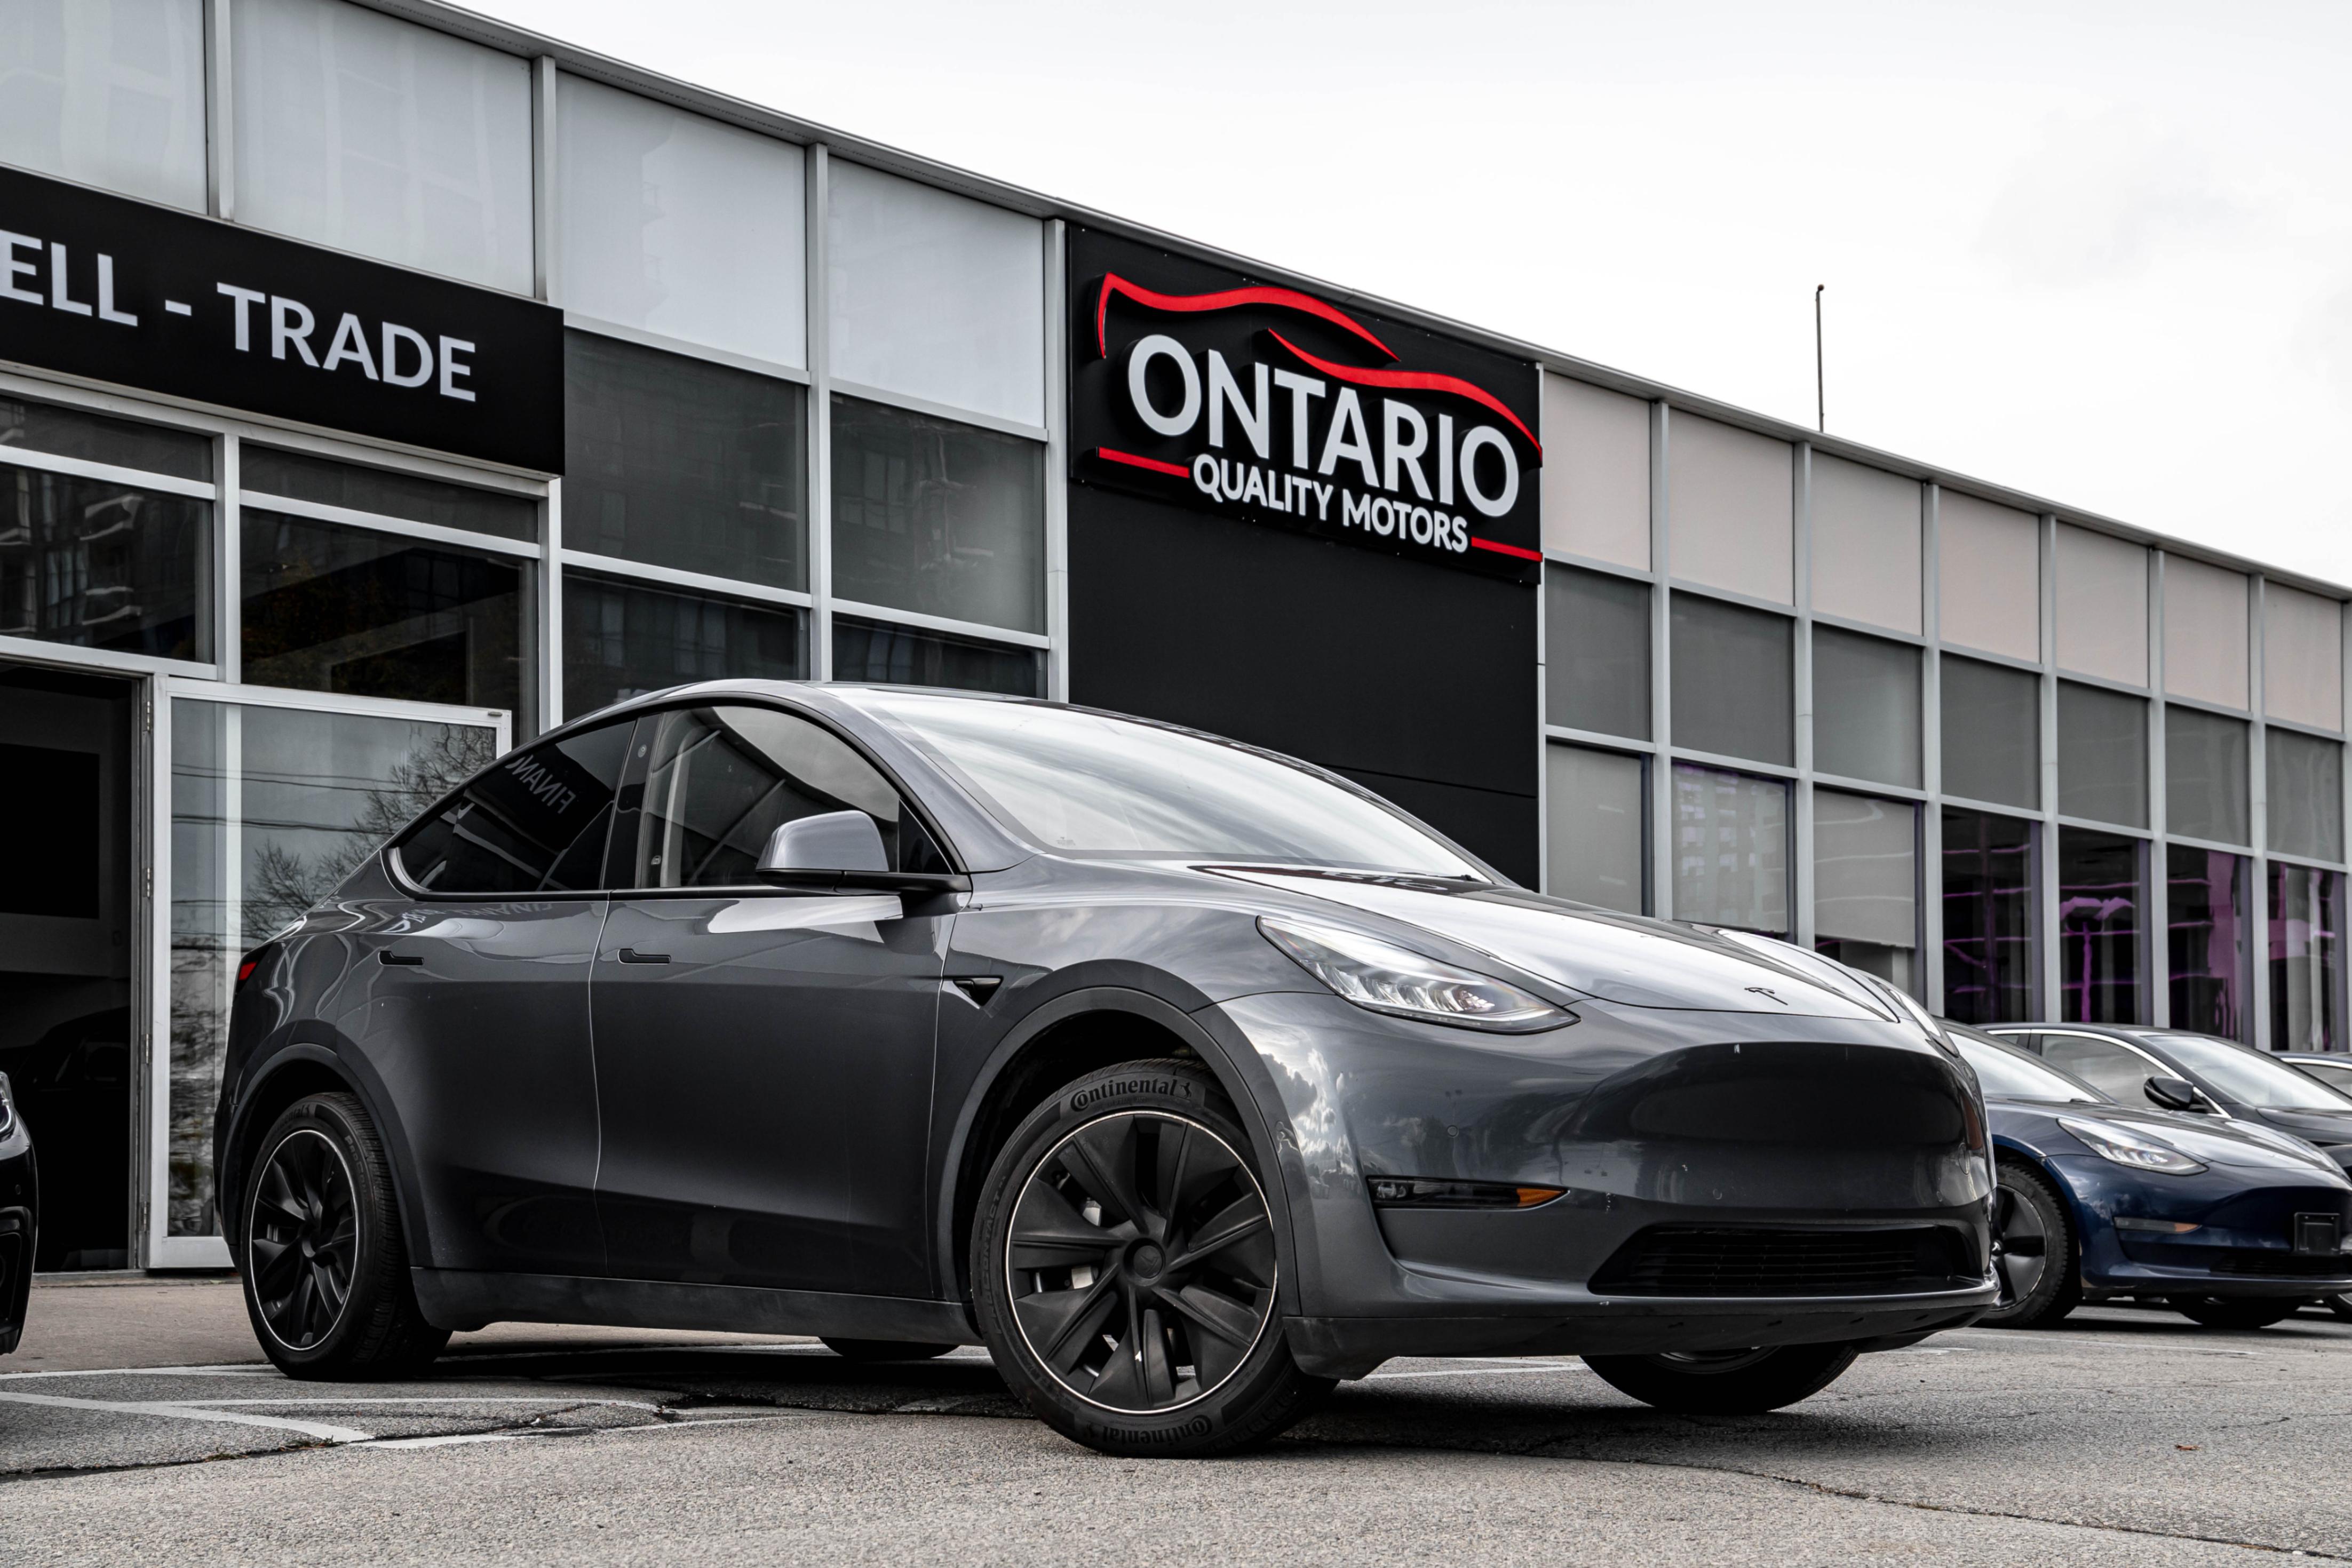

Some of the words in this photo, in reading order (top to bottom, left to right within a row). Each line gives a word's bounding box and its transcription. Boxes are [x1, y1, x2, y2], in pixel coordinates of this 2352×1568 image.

[0, 230, 138, 327] ELL
[165, 299, 192, 316] -
[217, 282, 475, 402] TRADE
[1129, 335, 1519, 517] ONTARIO
[1194, 453, 1334, 521] QUALITY
[1342, 489, 1468, 553] MOTORS
[1070, 1079, 1177, 1112] Continental
[1102, 1415, 1212, 1446] Continental
